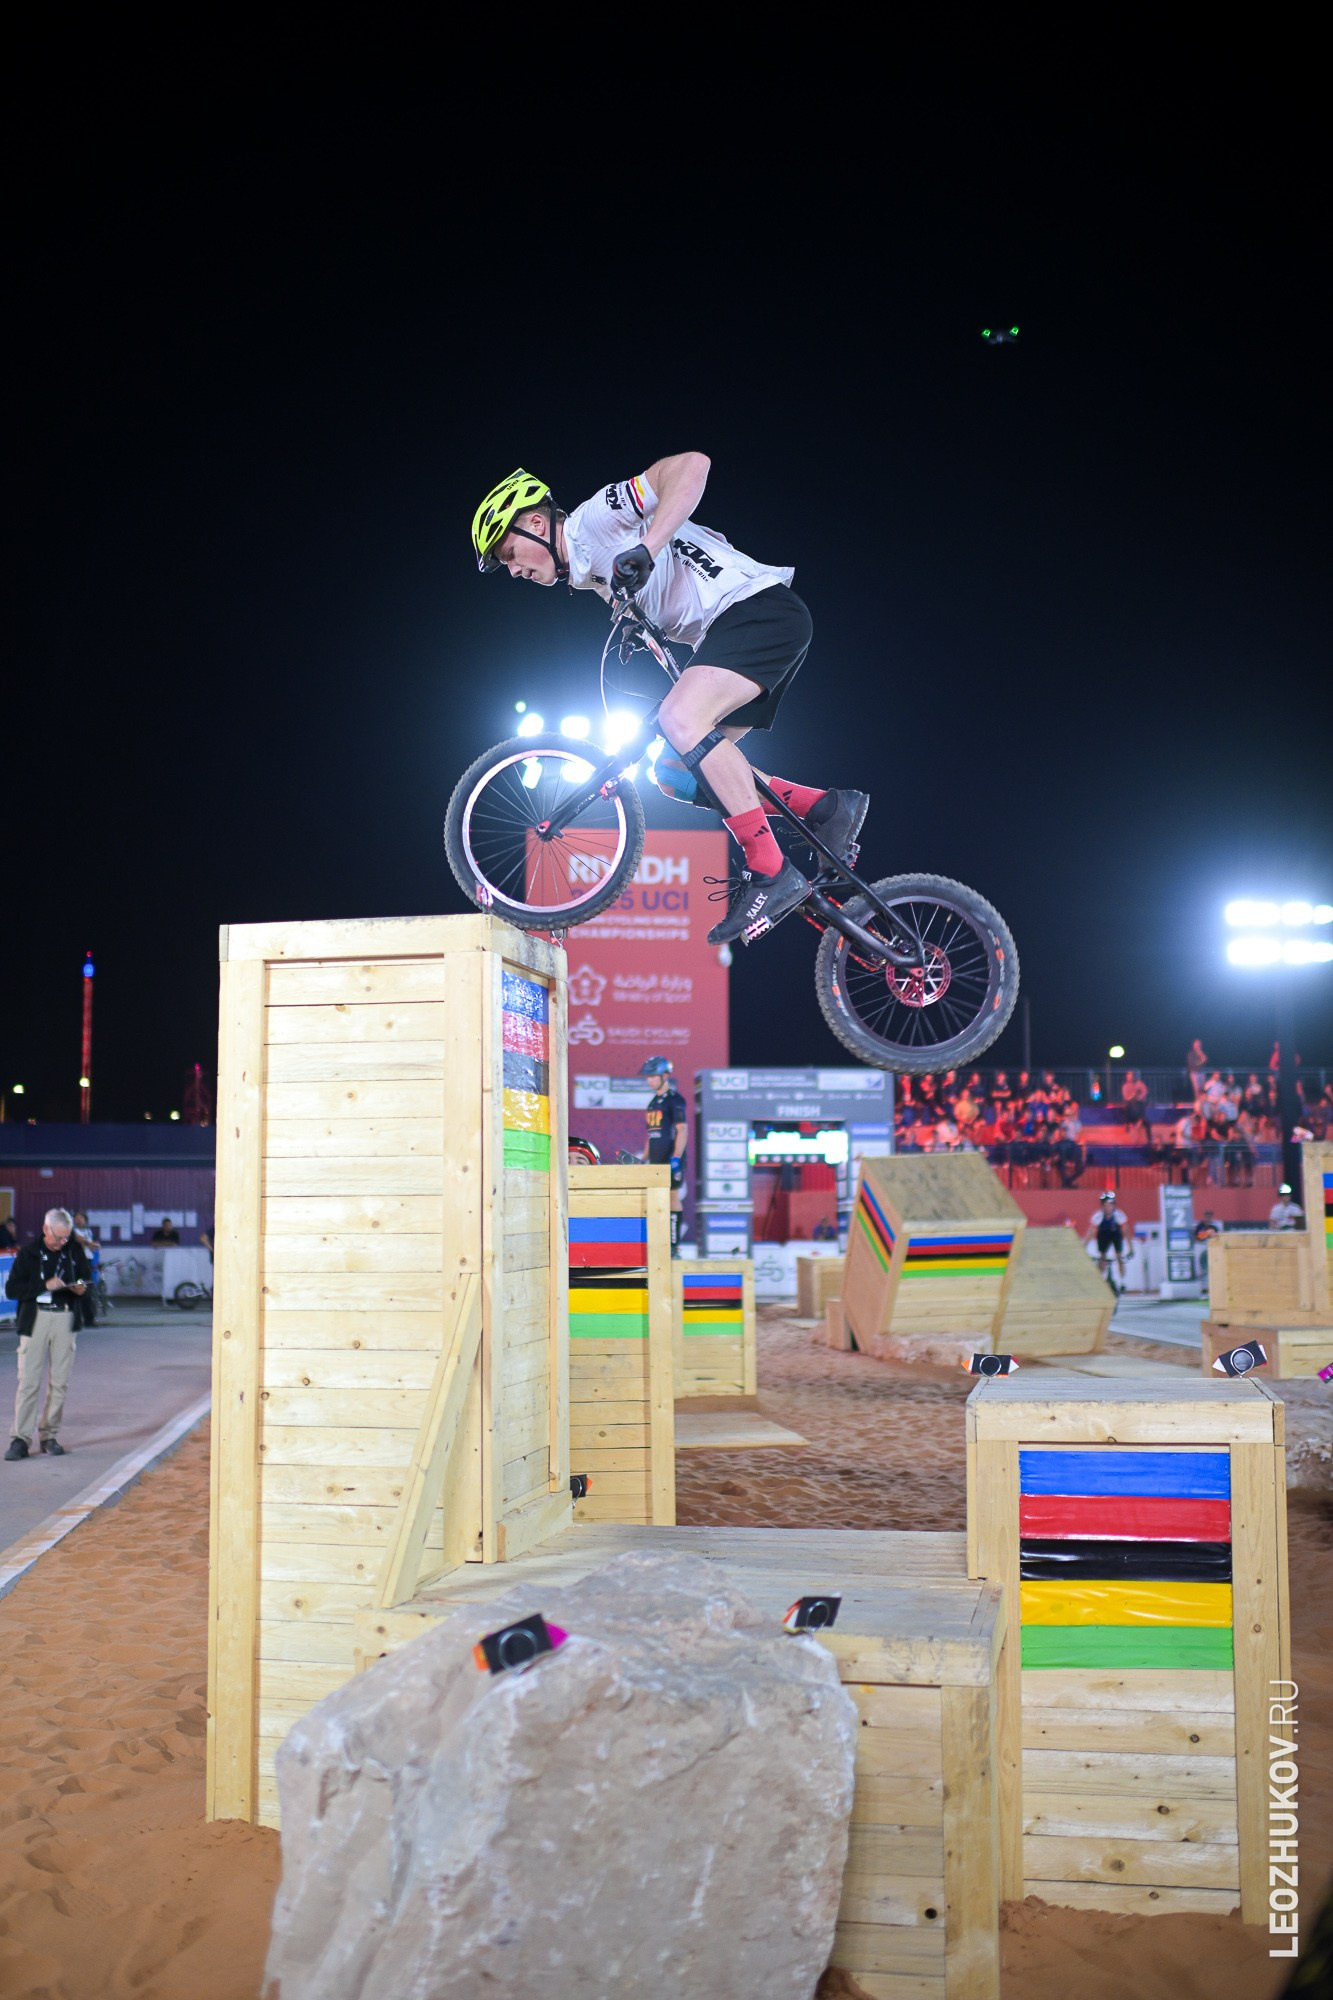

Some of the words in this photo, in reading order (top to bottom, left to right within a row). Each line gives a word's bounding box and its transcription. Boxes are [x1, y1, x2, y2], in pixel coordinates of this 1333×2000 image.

[606, 484, 623, 510] KTM
[673, 538, 724, 579] KTM
[569, 856, 689, 884] RIDH
[642, 890, 688, 910] UCI
[582, 1081, 607, 1090] UCI
[719, 1076, 744, 1087] UCI
[777, 1106, 820, 1117] FINISH
[716, 1127, 742, 1137] UCI
[1171, 1208, 1187, 1228] 2
